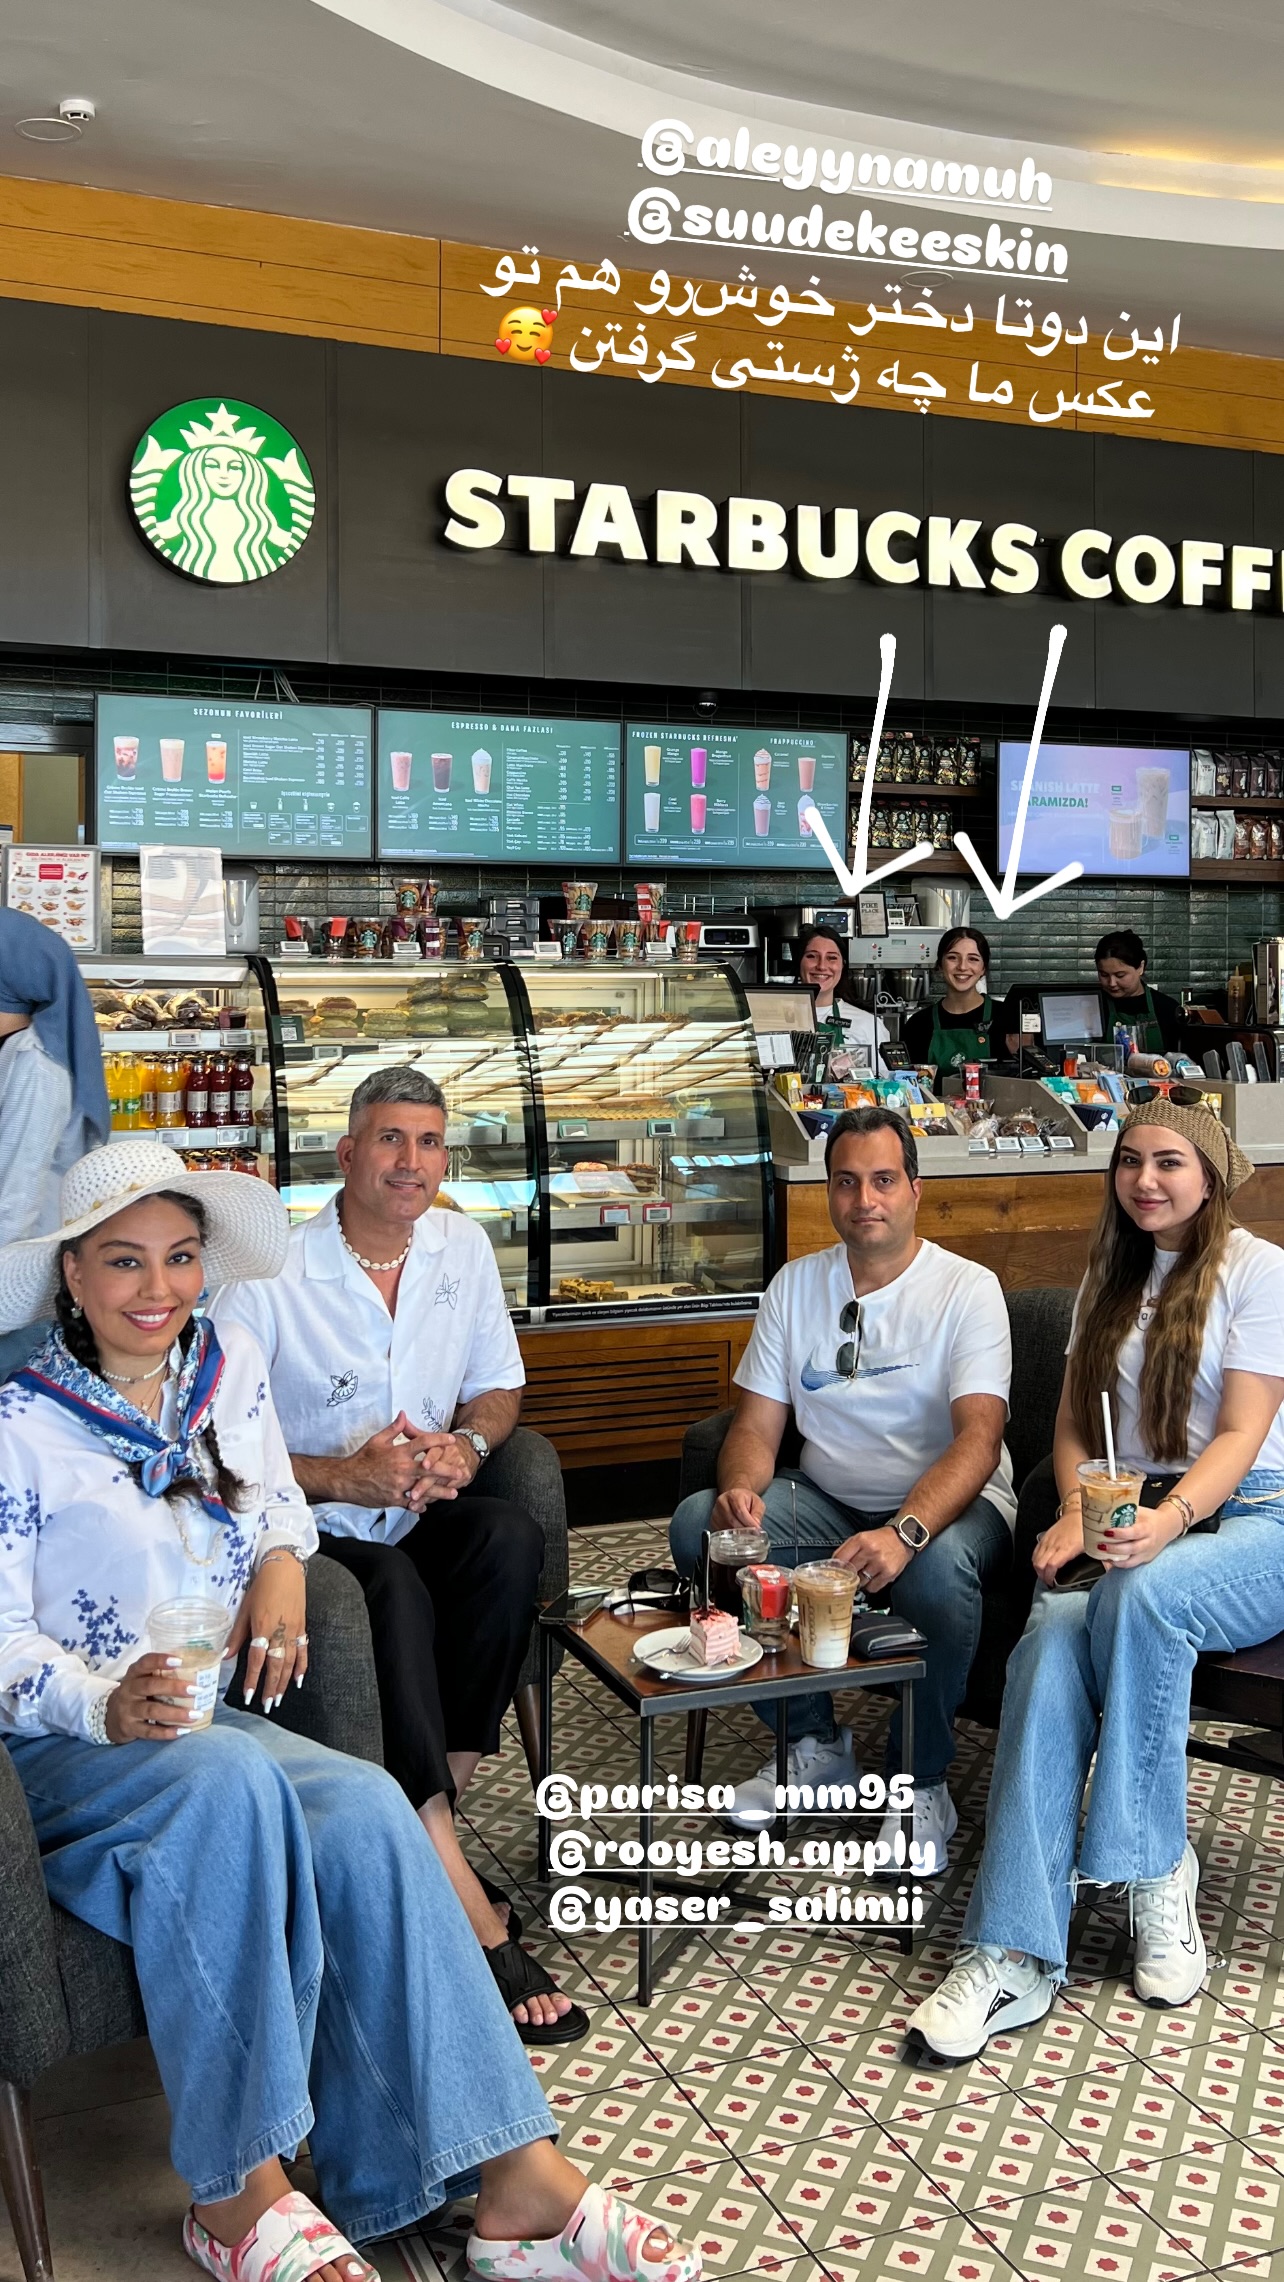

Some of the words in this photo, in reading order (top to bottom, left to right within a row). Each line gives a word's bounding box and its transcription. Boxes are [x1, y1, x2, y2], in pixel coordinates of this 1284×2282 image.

[445, 469, 1038, 594] STARBUCKS
[1061, 529, 1284, 614] COFF
[451, 721, 489, 731] ESPRESSO
[632, 731, 658, 739] FROZEN
[660, 732, 701, 741] STARBUCKS
